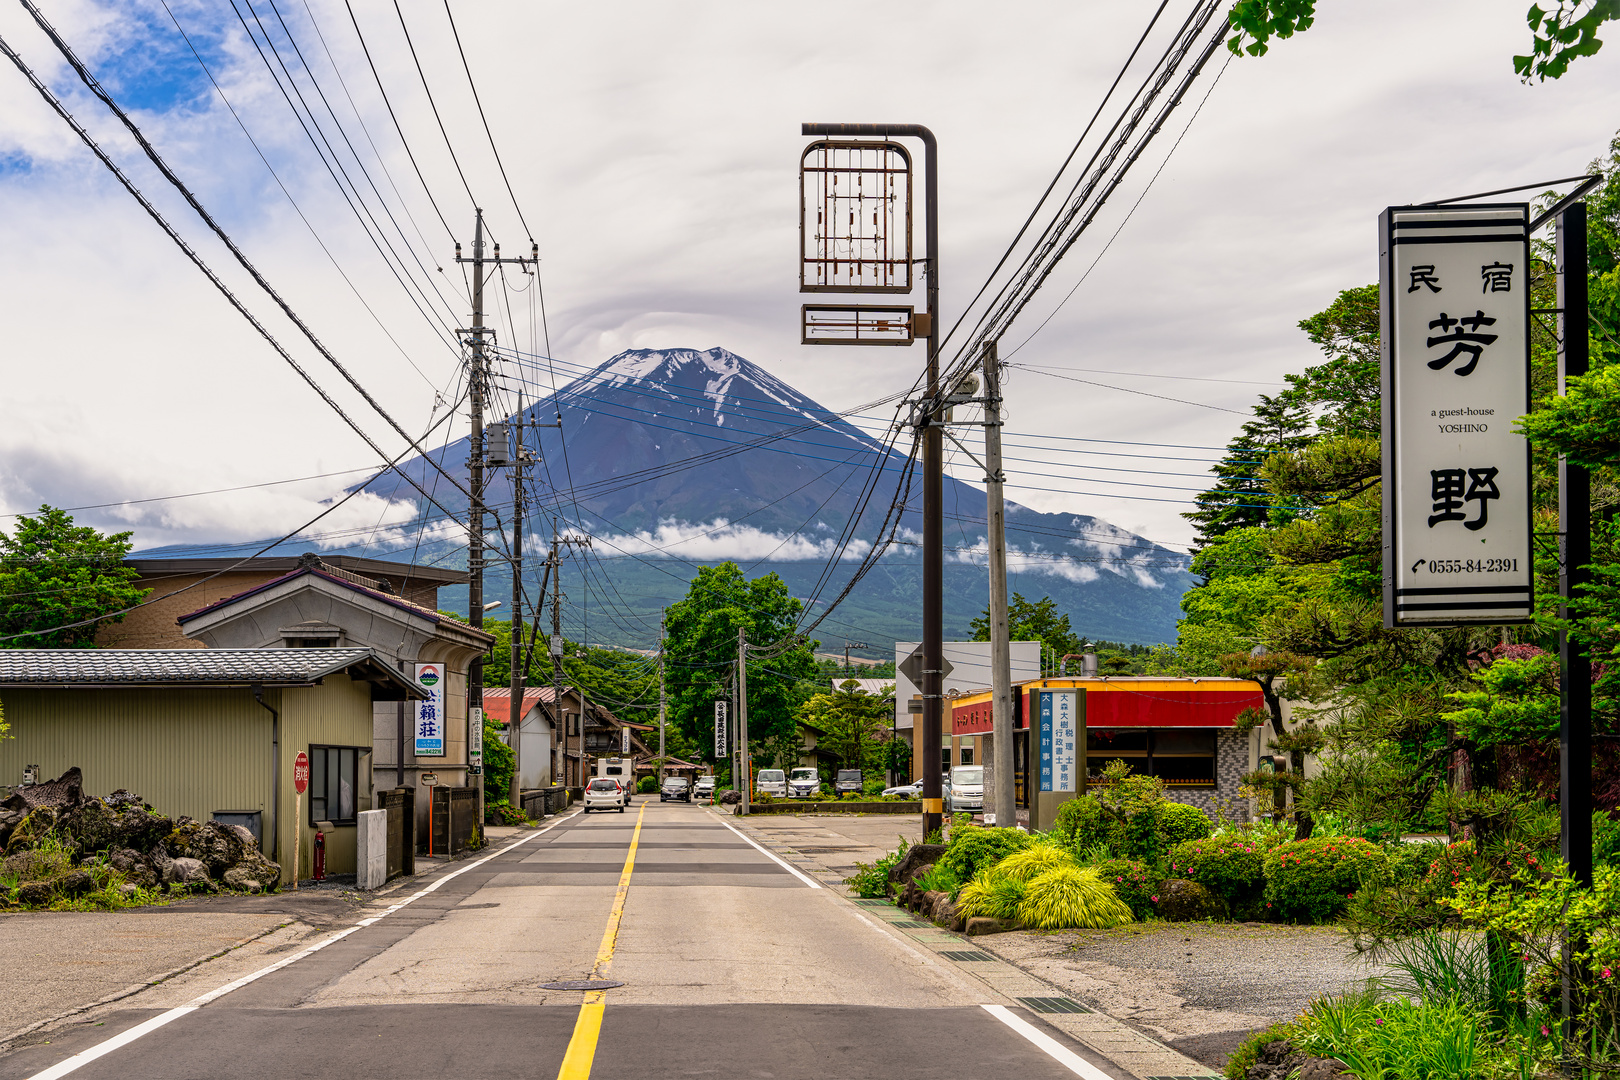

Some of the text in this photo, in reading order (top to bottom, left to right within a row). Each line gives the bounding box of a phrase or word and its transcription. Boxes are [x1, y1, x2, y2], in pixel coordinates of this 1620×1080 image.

[1408, 261, 1514, 294] 民宿
[1431, 407, 1495, 419] a guest-house
[1438, 424, 1488, 433] YOSHINO
[1429, 558, 1518, 573] 0555-84-2391
[1042, 693, 1050, 790] 大森会計事務所
[1055, 729, 1063, 764] 行政書士
[1065, 729, 1074, 764] 税理士
[295, 765, 308, 781] 消火栓
